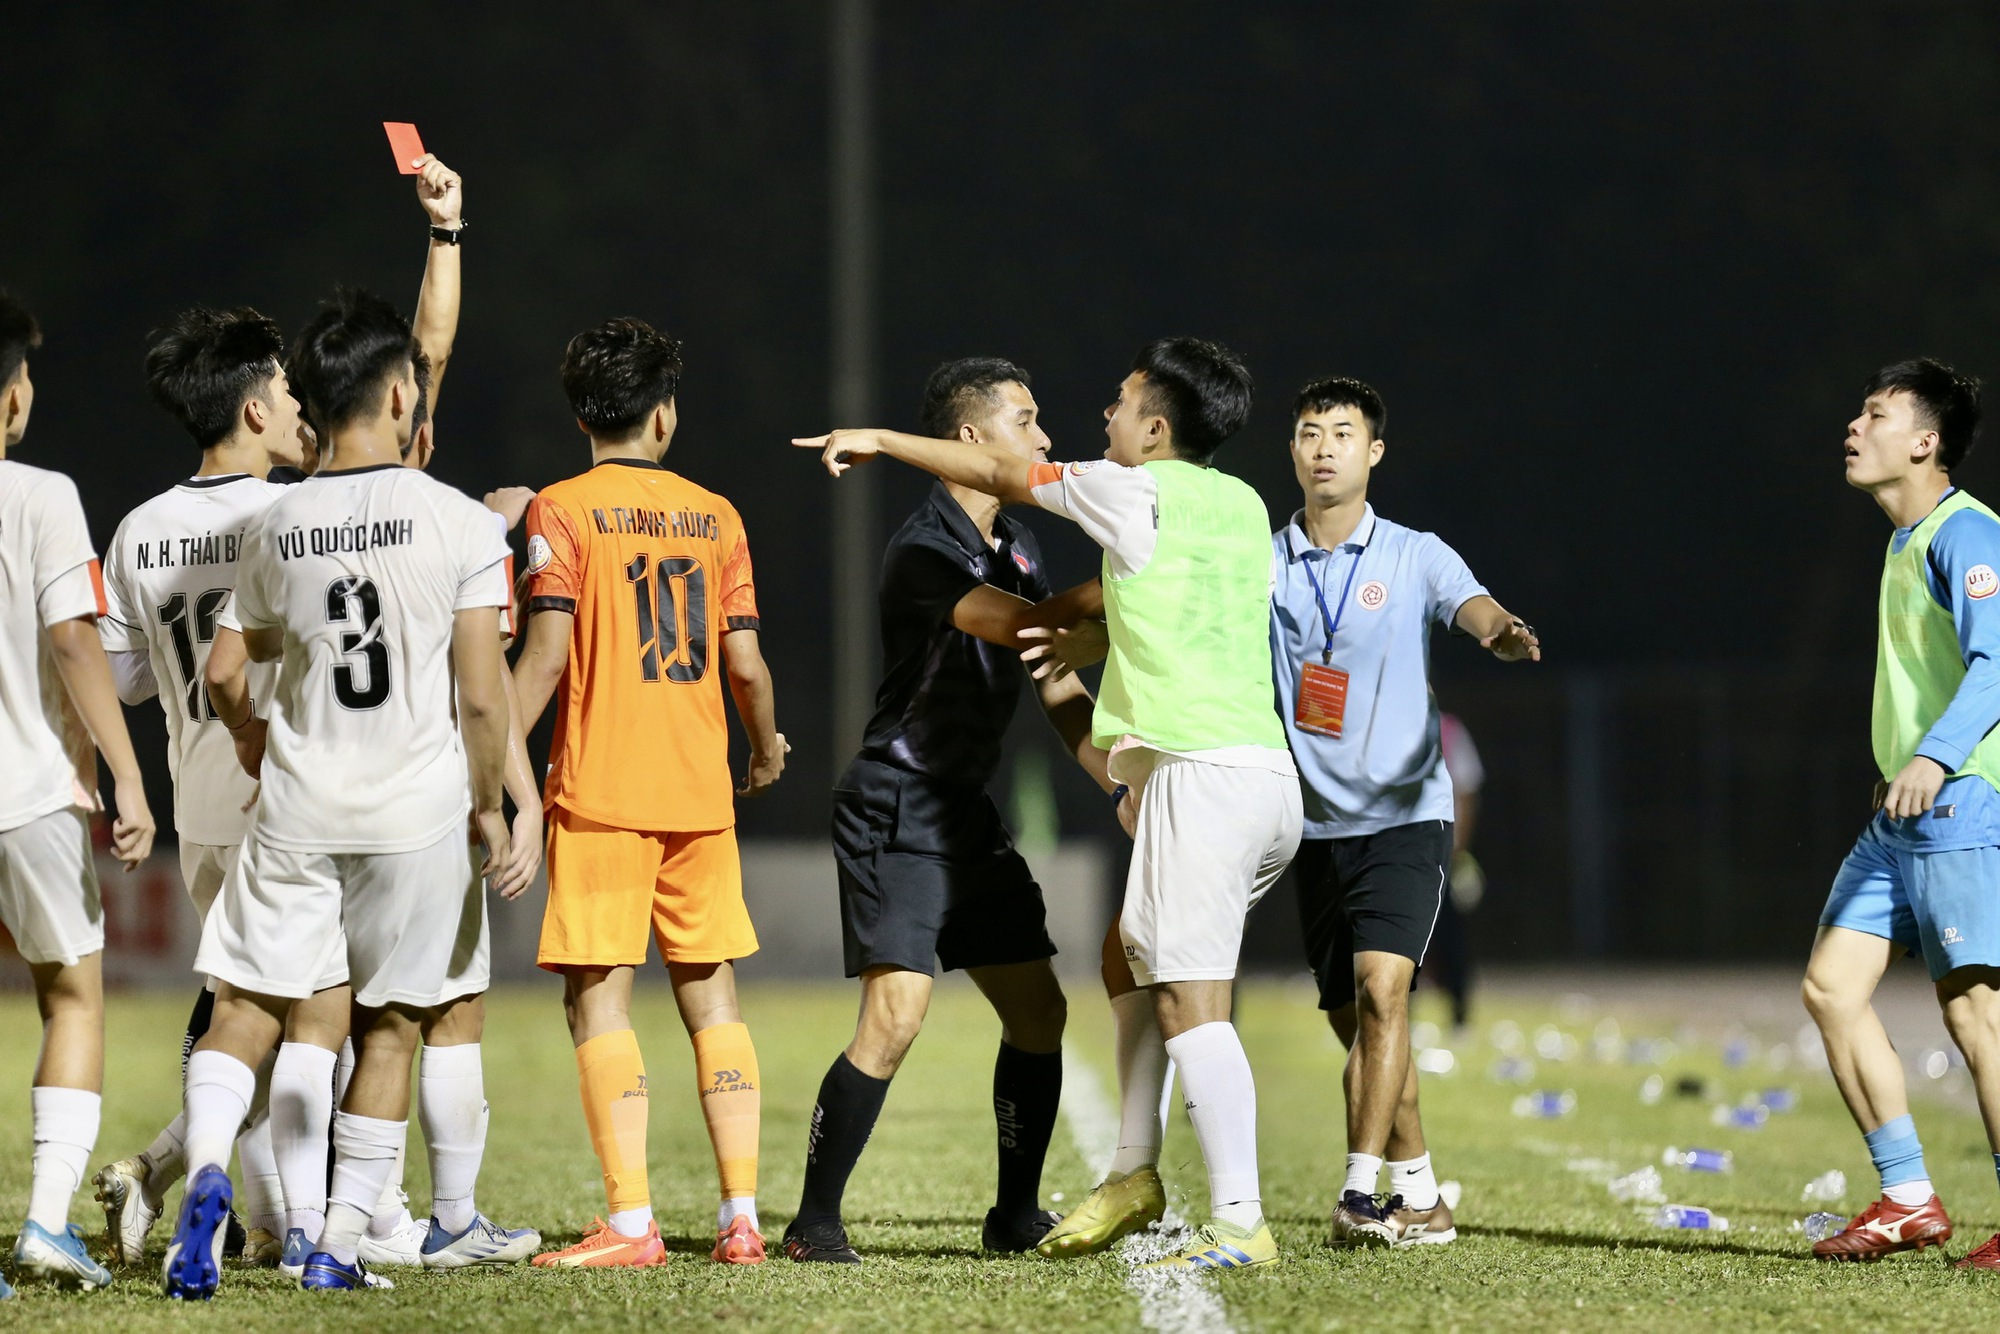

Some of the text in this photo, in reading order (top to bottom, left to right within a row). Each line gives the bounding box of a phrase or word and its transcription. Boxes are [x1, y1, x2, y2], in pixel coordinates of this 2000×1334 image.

[278, 516, 413, 561] VŨ QUỐC ANH
[670, 506, 718, 541] HÙNG
[137, 542, 154, 570] N.
[159, 539, 175, 567] H.
[180, 530, 220, 566] THÁI
[624, 553, 710, 685] 10
[324, 575, 393, 712] 3
[622, 1090, 649, 1098] BUL
[996, 1096, 1024, 1149] mitre
